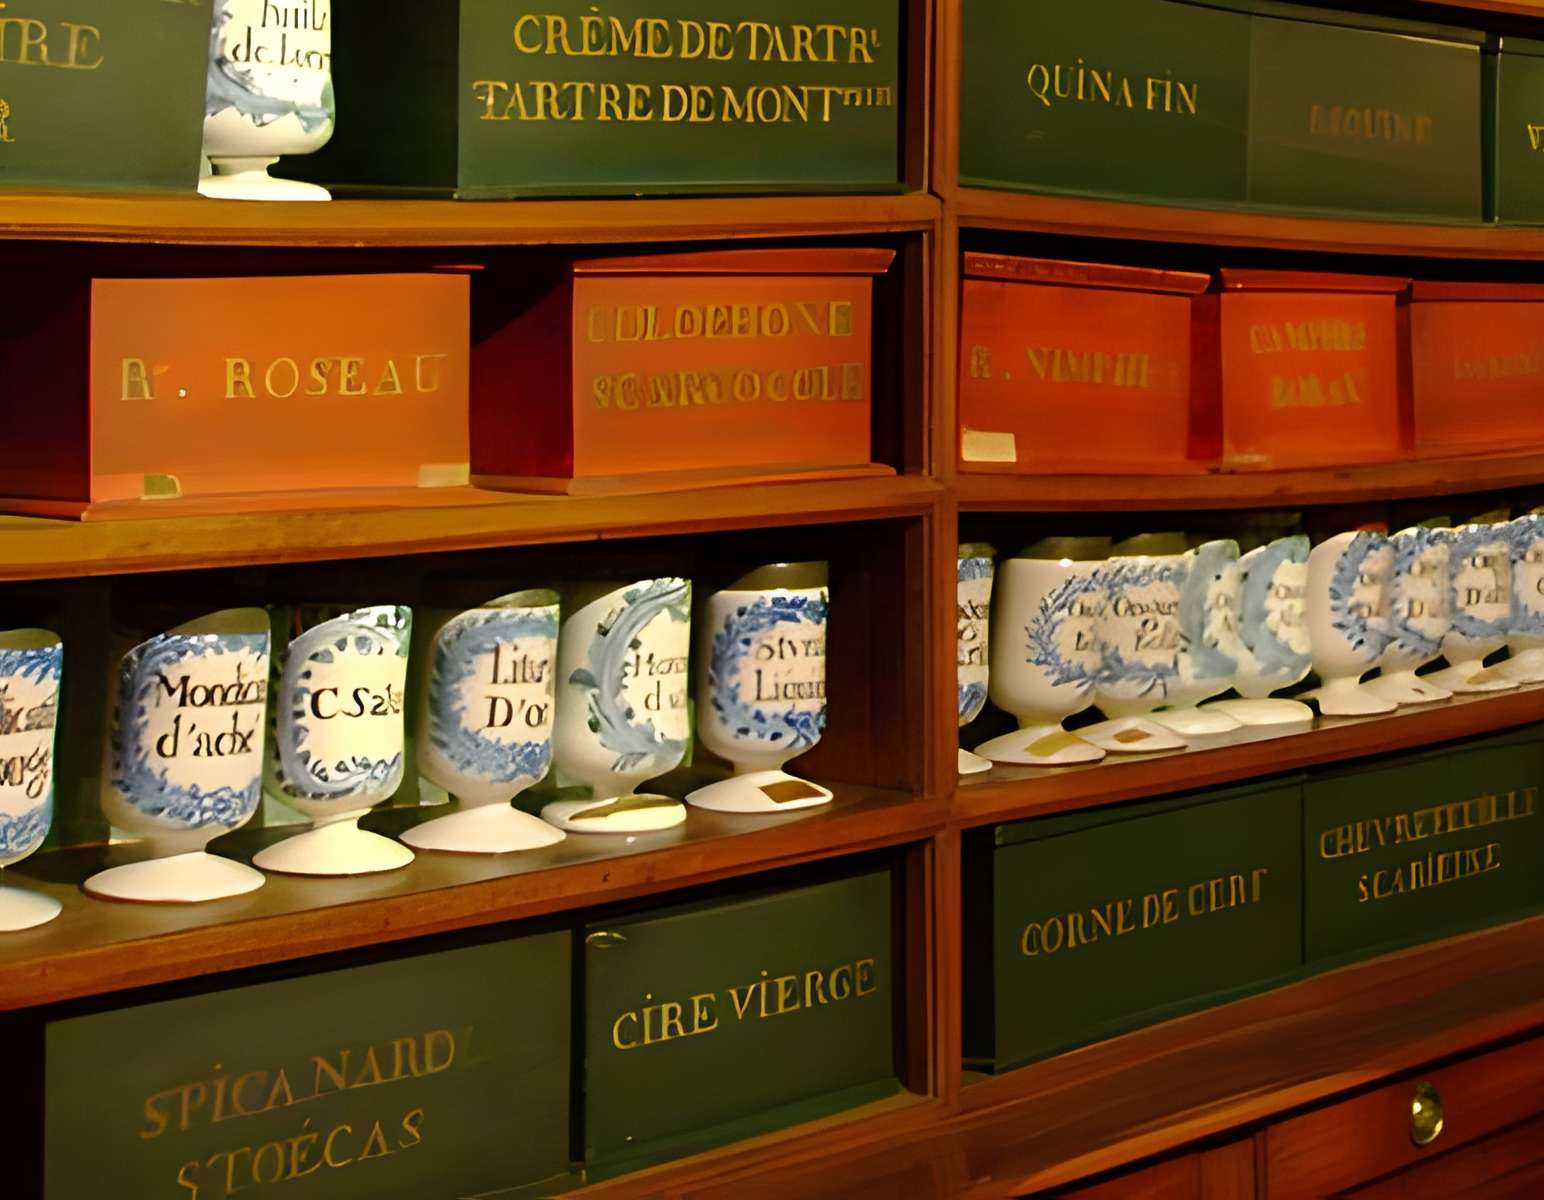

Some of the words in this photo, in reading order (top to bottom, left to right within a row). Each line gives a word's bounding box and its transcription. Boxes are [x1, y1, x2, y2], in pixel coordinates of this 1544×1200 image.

[678, 19, 735, 60] DE
[472, 80, 653, 122] TARTRE
[661, 84, 716, 122] DE
[1027, 57, 1133, 108] QUINA
[1146, 69, 1198, 115] FIN
[1142, 887, 1179, 929] DE
[611, 993, 719, 1050] CIRE
[727, 958, 878, 1020] VIERGE
